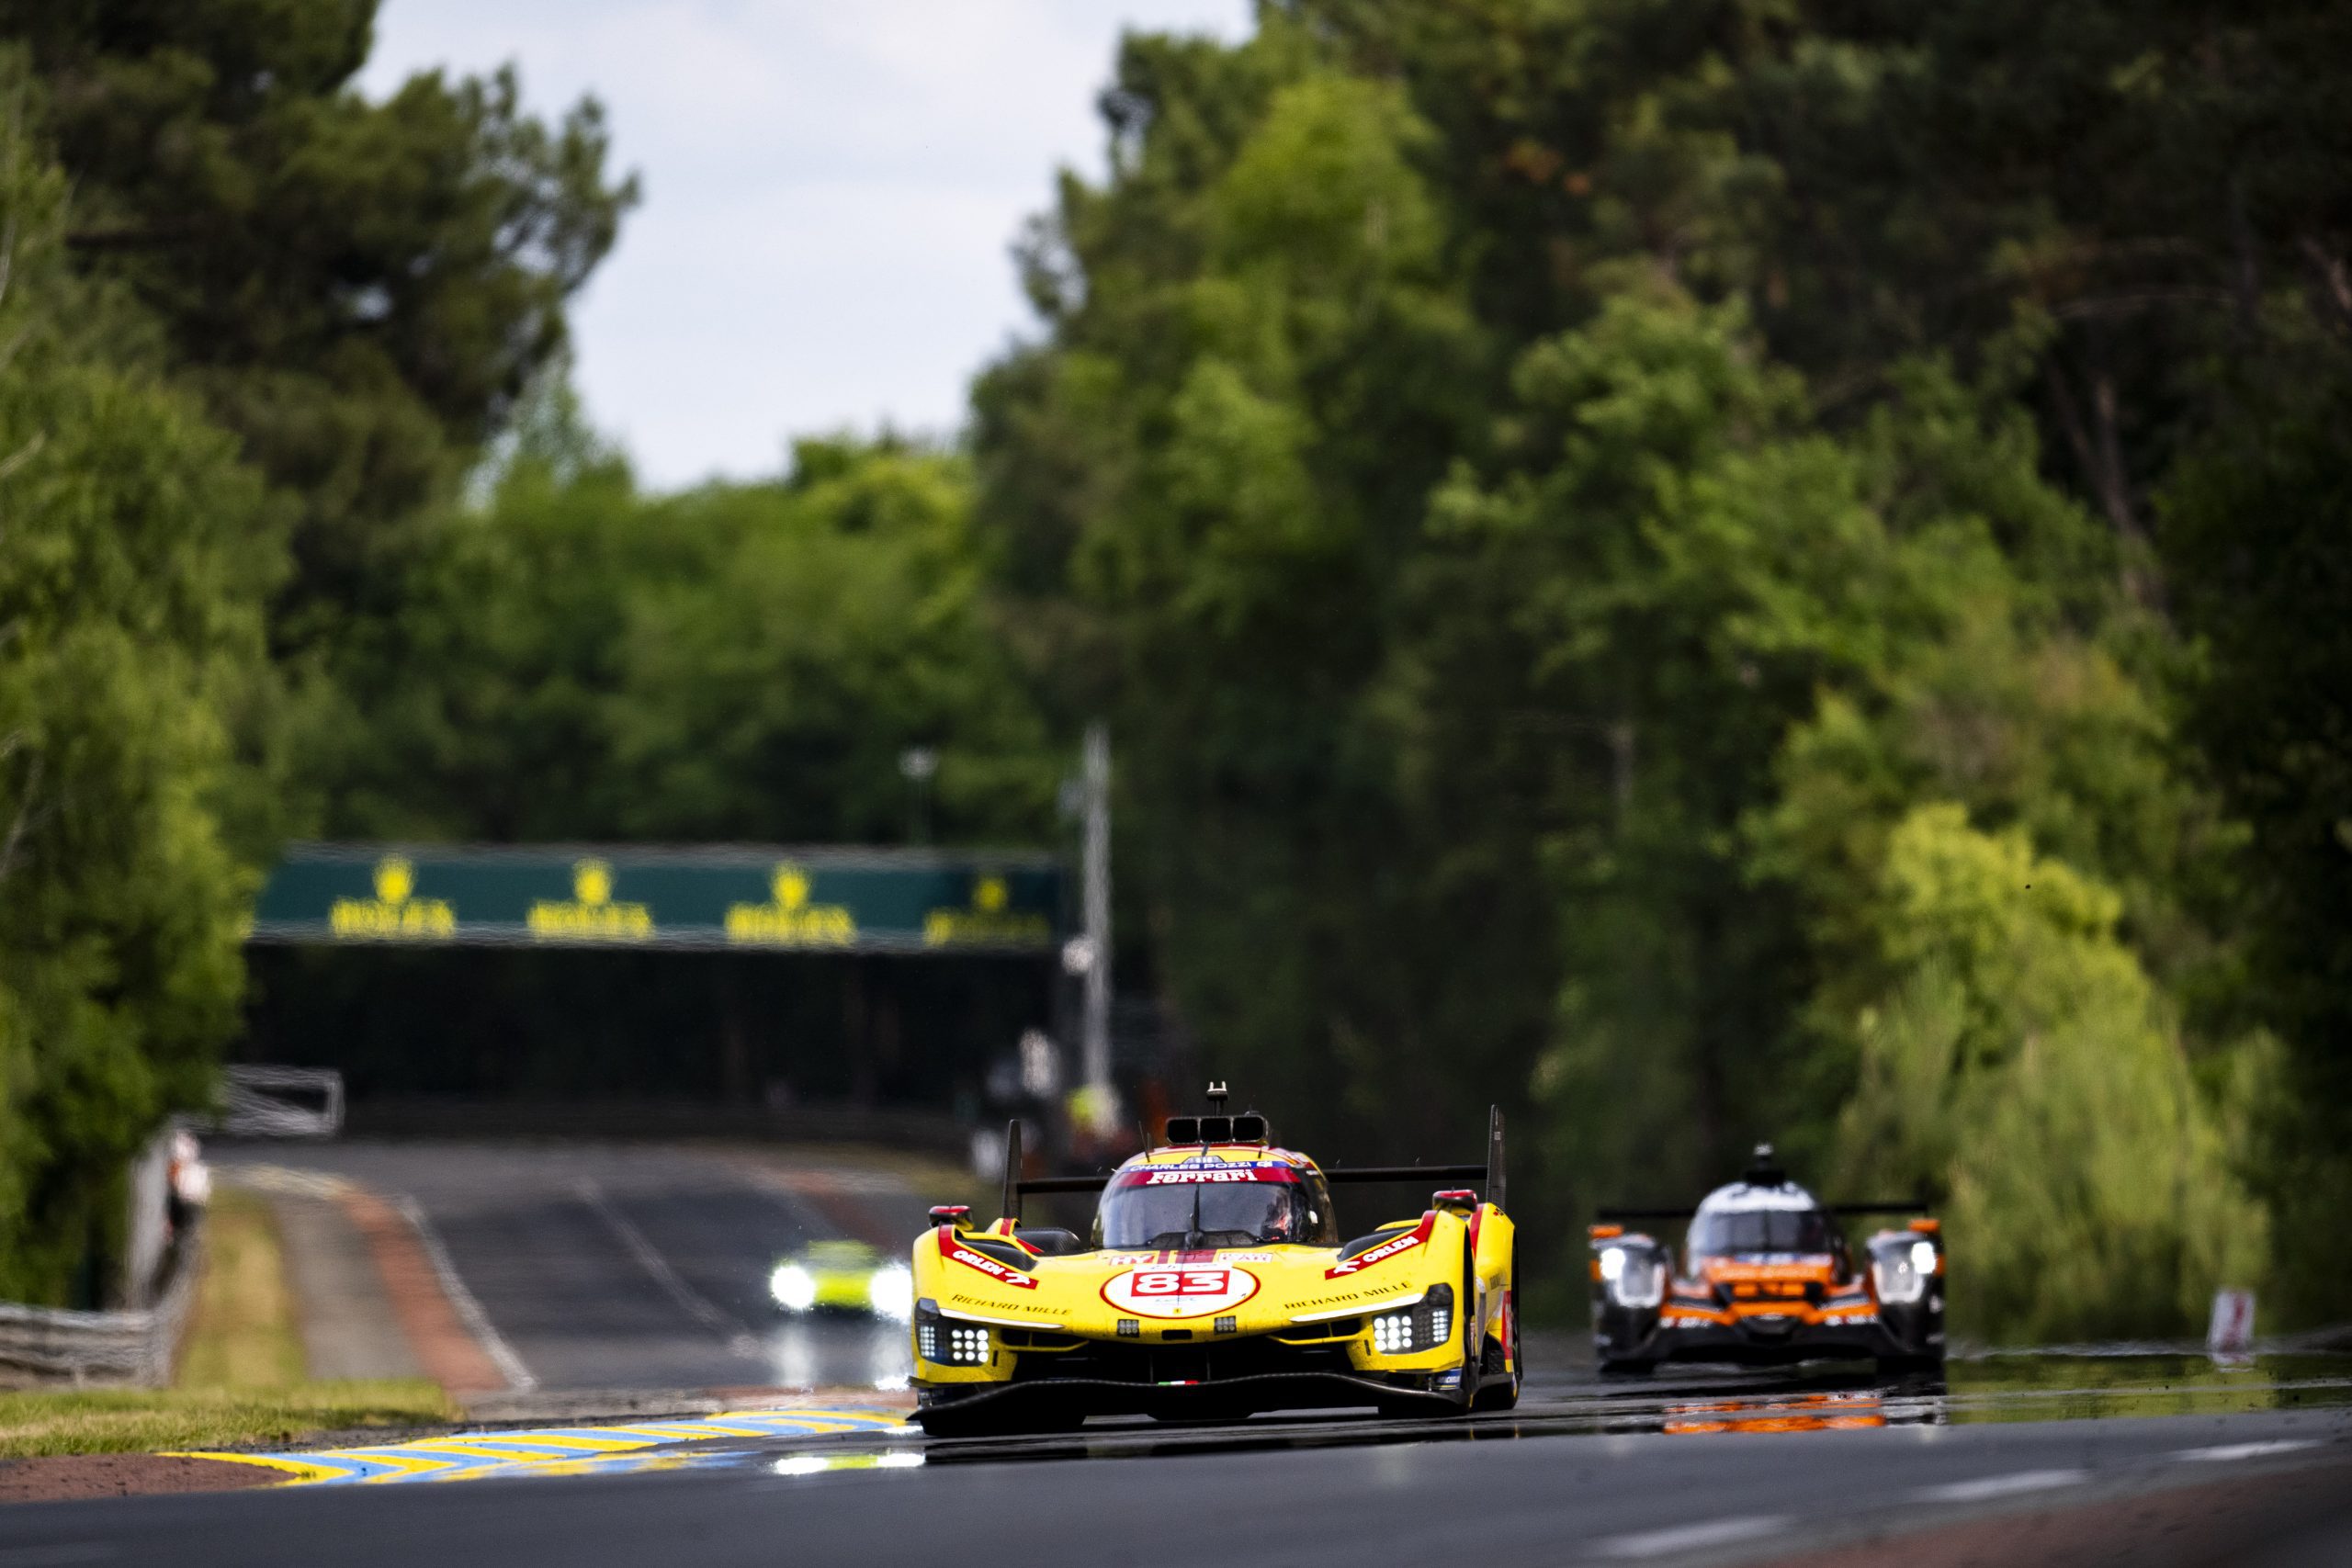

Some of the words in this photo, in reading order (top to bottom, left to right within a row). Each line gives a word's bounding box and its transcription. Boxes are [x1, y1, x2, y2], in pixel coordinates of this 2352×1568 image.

[1129, 1163, 1200, 1172] CHARLES
[1204, 1161, 1252, 1170] POZZI
[1147, 1168, 1259, 1185] Ferrari
[1363, 1235, 1419, 1262] ORLEN
[952, 1250, 1006, 1275] ORLEN
[1136, 1271, 1225, 1294] 83
[952, 1293, 1019, 1311] RICHARD
[1022, 1305, 1072, 1316] MILLE
[1284, 1292, 1360, 1310] RICHARD
[1363, 1280, 1413, 1298] MILLE
